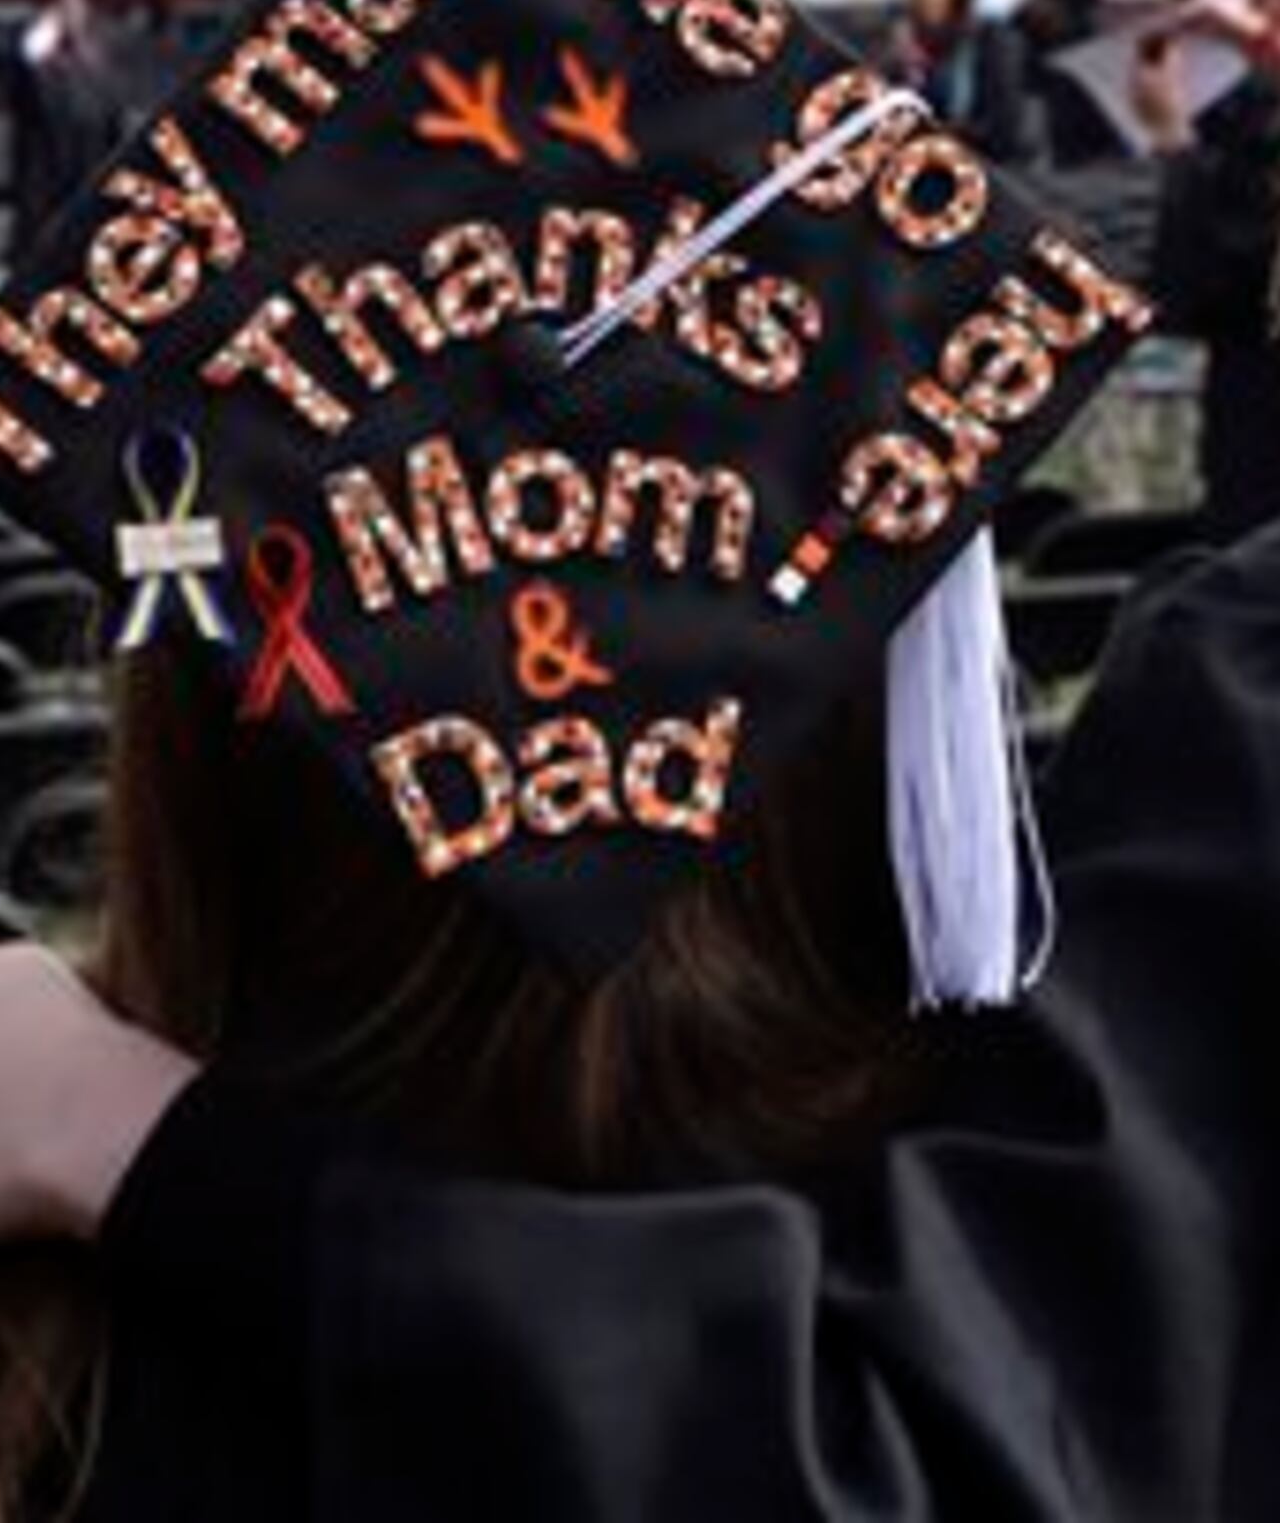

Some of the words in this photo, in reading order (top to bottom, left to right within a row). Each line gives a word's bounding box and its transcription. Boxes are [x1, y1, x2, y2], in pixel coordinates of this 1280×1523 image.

[200, 200, 824, 438] Thanks
[323, 433, 756, 614] Mom
[511, 579, 612, 701] &
[372, 696, 744, 878] Dad
